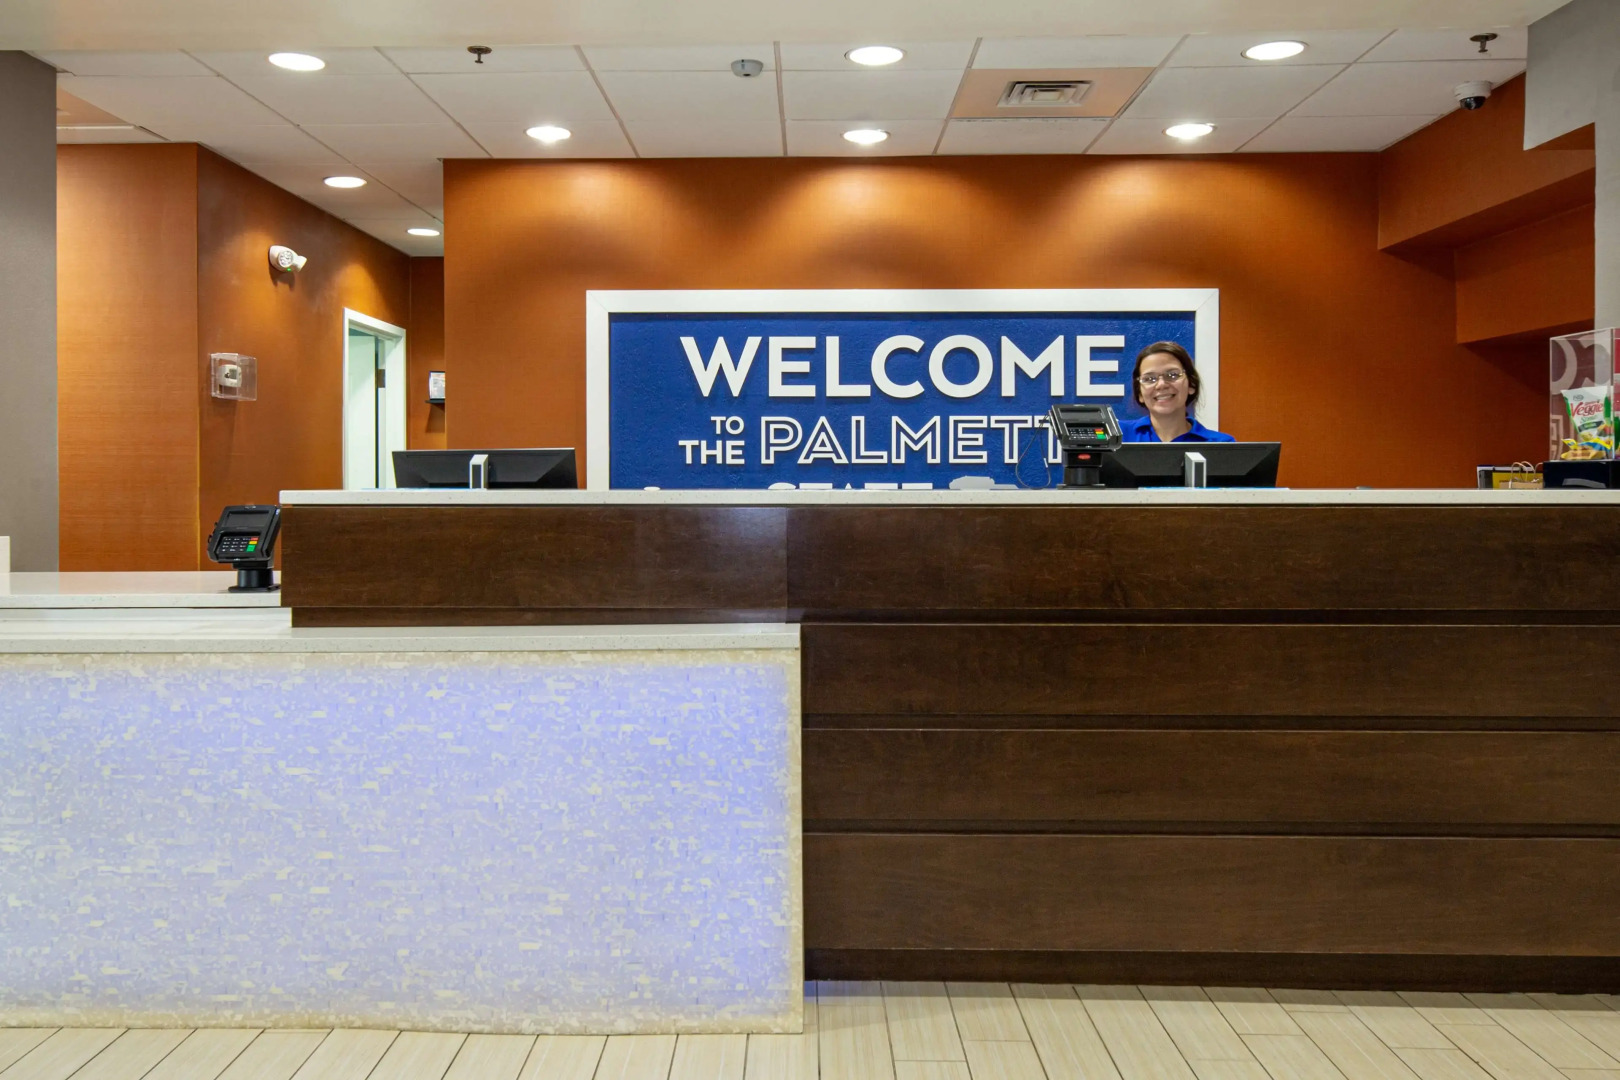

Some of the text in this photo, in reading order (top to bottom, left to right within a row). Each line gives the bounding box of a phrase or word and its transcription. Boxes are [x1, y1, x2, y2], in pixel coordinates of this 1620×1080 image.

[680, 334, 1126, 399] WELCOME
[711, 415, 748, 436] TO
[1570, 402, 1603, 418] Veggie
[679, 415, 1063, 465] THE PALMETT
